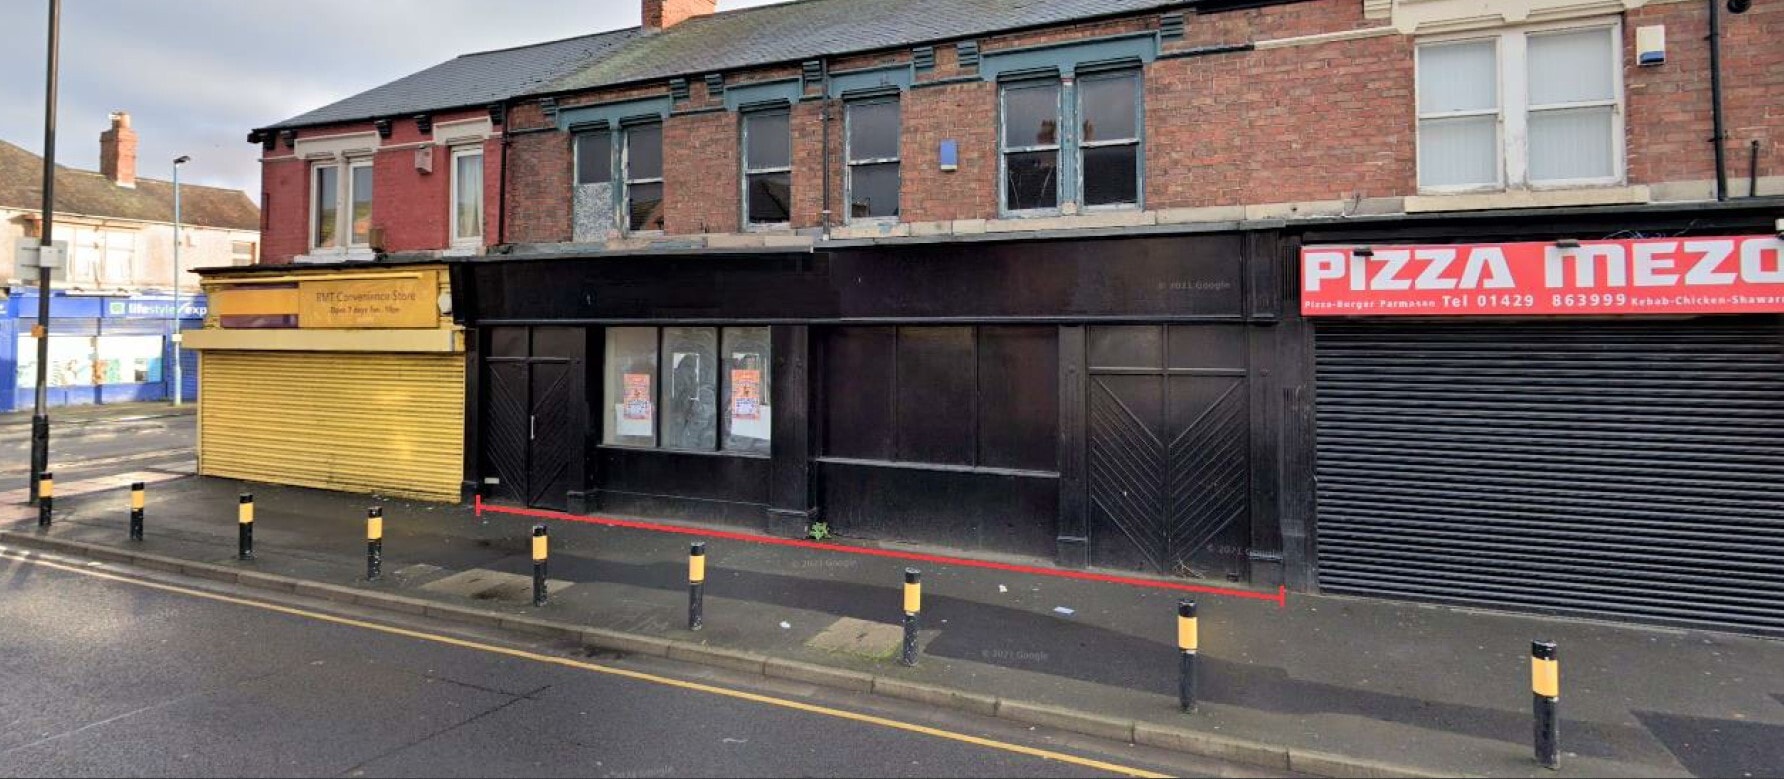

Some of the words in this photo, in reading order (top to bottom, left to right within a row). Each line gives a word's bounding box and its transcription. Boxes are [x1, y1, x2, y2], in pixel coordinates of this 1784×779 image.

[1304, 247, 1516, 292] PIZZA
[336, 290, 390, 302] Convenience
[391, 289, 416, 301] Store
[1442, 295, 1468, 307] Tel
[1477, 295, 1534, 307] 01429
[1552, 293, 1626, 307] 863999
[128, 302, 176, 316] lifestyle
